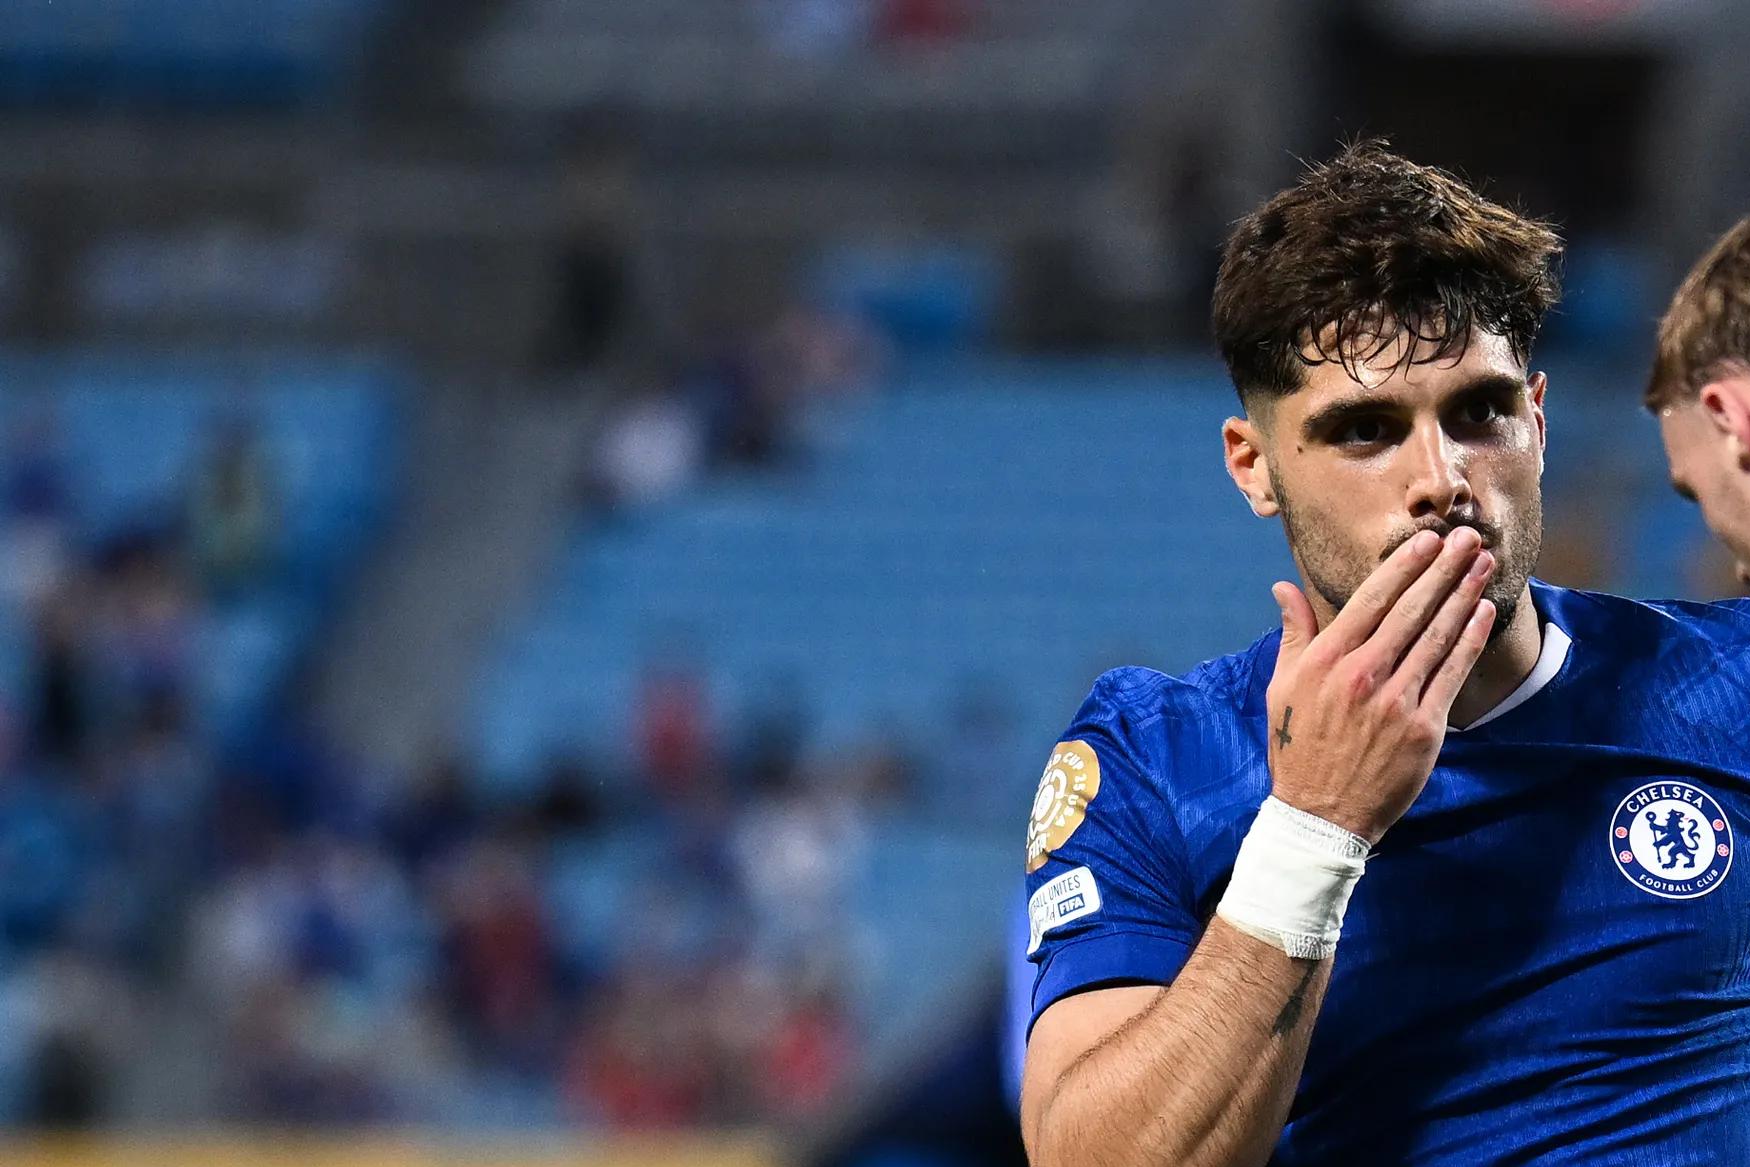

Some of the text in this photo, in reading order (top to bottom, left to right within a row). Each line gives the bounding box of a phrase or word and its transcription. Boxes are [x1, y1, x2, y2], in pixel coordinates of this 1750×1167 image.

[1062, 751, 1085, 771] CUP
[1626, 786, 1704, 813] CHELSEA
[1048, 874, 1081, 900] UNITES
[1639, 868, 1719, 892] FOOTBALL CLUB
[1059, 895, 1084, 916] FIFA
